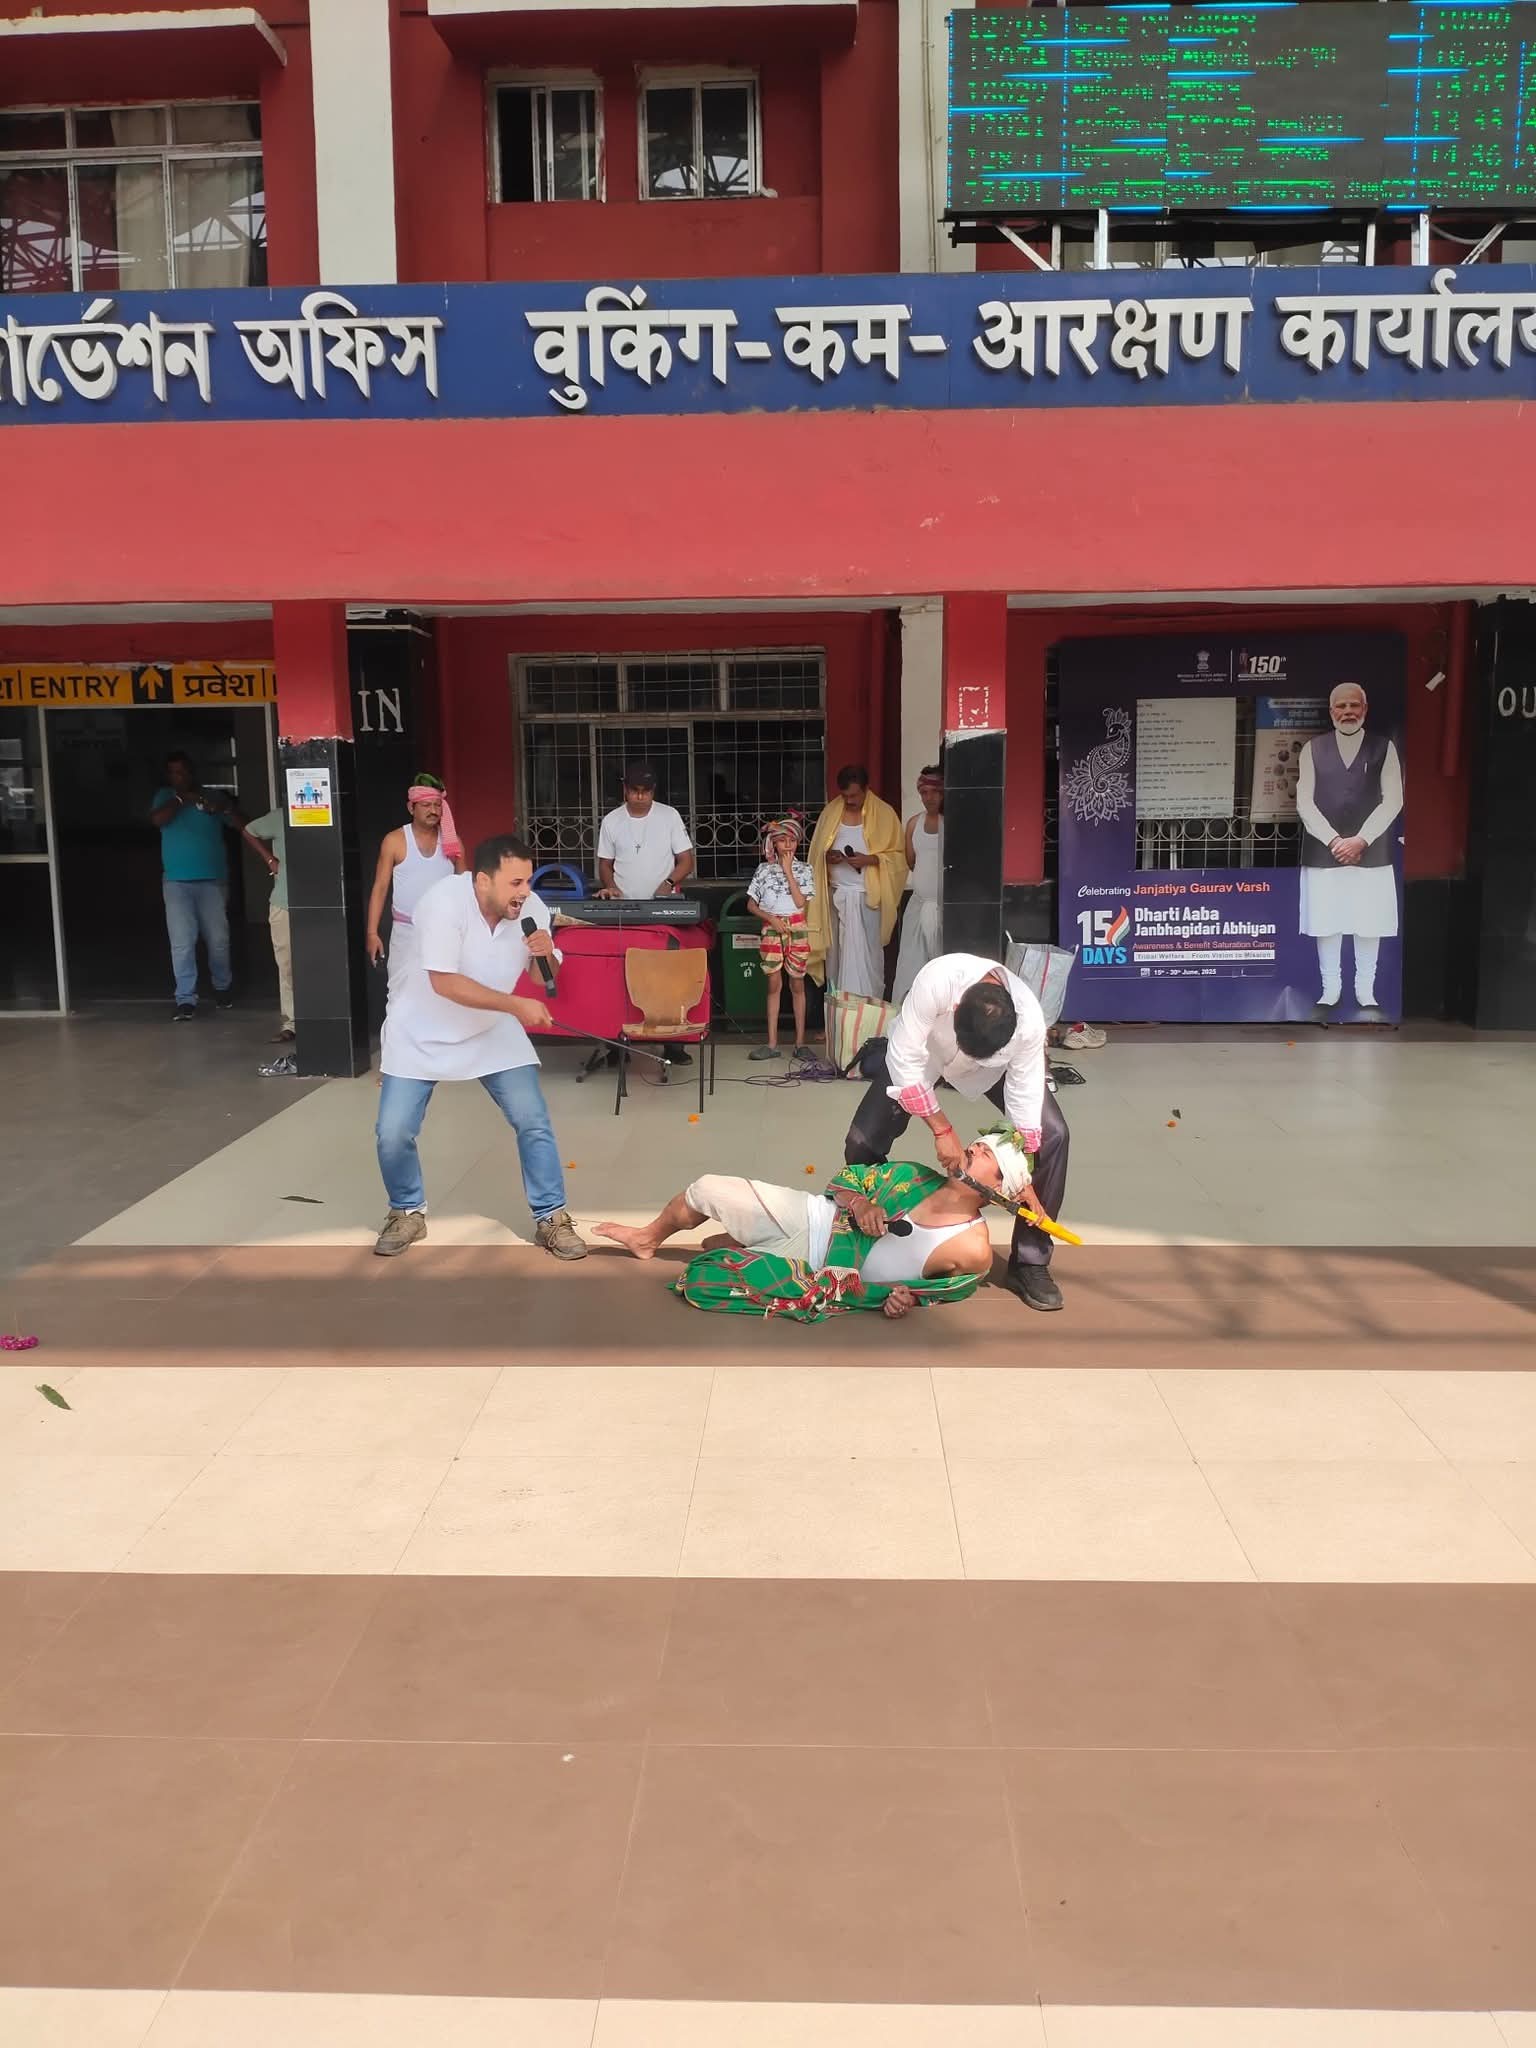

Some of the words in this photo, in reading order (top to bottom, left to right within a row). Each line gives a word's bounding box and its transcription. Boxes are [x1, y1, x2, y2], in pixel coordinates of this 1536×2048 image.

[233, 290, 444, 400] অফিস
[973, 296, 1253, 380] आरक्षण
[30, 675, 120, 699] ENTRY
[183, 664, 256, 698] प्रवेश
[358, 688, 404, 732] IN
[1077, 884, 1131, 898] Celebrating
[1133, 883, 1186, 896] Janjatiya
[1189, 883, 1233, 894] Gaurav
[1236, 881, 1270, 892] Varsh
[1134, 907, 1180, 922] Dharti
[1182, 906, 1220, 921] Aaba
[1077, 910, 1114, 946] 15
[1134, 922, 1221, 939] Janbhagidari
[1222, 921, 1277, 938] Abhiyan
[1083, 946, 1127, 965] DAYS
[1132, 942, 1175, 950] Awareness
[1183, 941, 1210, 949] Benefit
[1212, 940, 1251, 949] Saturation
[1252, 940, 1276, 950] Camp
